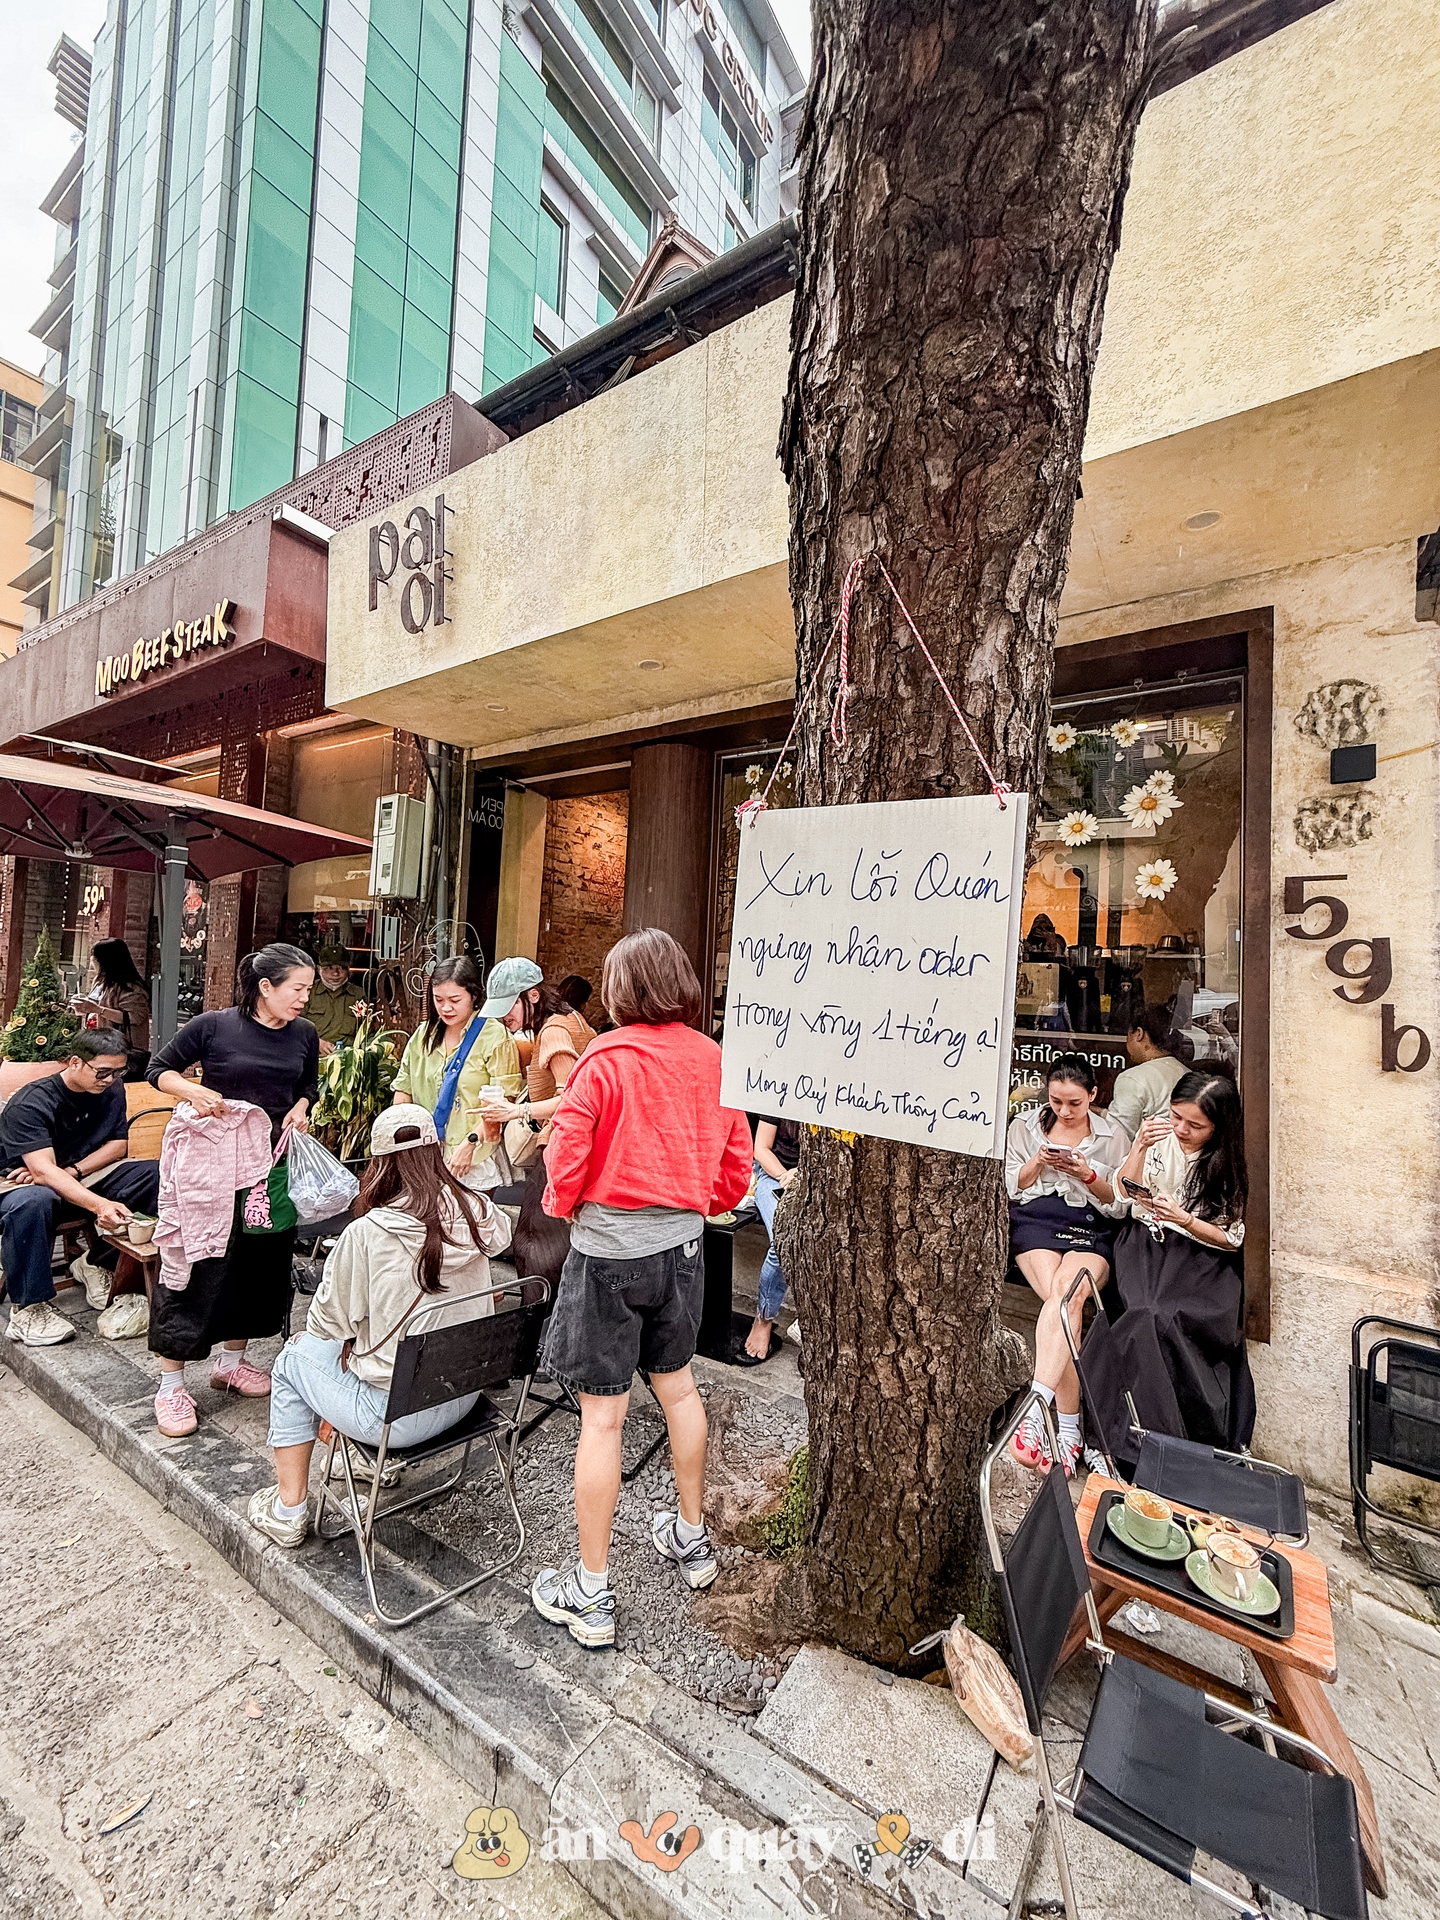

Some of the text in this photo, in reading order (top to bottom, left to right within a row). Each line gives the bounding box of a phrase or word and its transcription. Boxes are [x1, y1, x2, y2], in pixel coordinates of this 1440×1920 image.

[722, 41, 774, 143] GROUP
[745, 850, 833, 910] Xin
[914, 850, 1010, 903] Quán
[732, 993, 792, 1049] trong
[746, 1067, 789, 1107] Mong
[794, 1074, 828, 1114] Quý
[891, 1091, 938, 1133] Thông
[941, 1091, 993, 1126] Cảm
